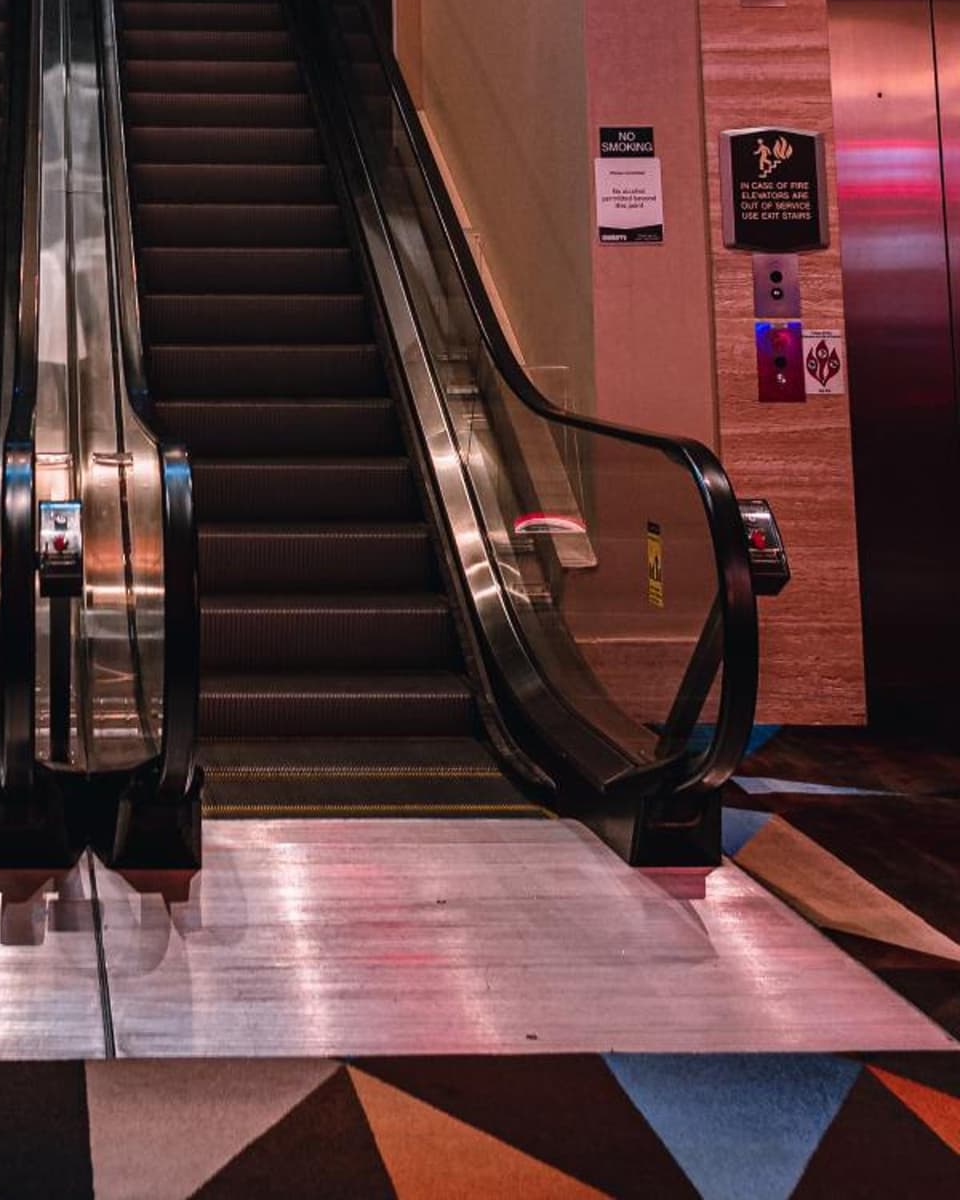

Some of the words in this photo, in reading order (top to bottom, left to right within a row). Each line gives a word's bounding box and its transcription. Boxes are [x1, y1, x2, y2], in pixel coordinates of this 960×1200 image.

[618, 131, 636, 141] NO
[601, 142, 653, 152] SMOKING
[751, 182, 774, 190] CASE
[776, 182, 789, 190] OF
[790, 182, 809, 190] FIRE
[741, 191, 789, 200] ELEVATORS
[792, 191, 809, 200] ARE
[741, 201, 758, 210] OUT
[761, 201, 774, 210] OF
[775, 201, 811, 210] SERVICE
[741, 211, 759, 220] USE
[761, 211, 780, 220] EXIT
[781, 211, 811, 220] STAIRS
